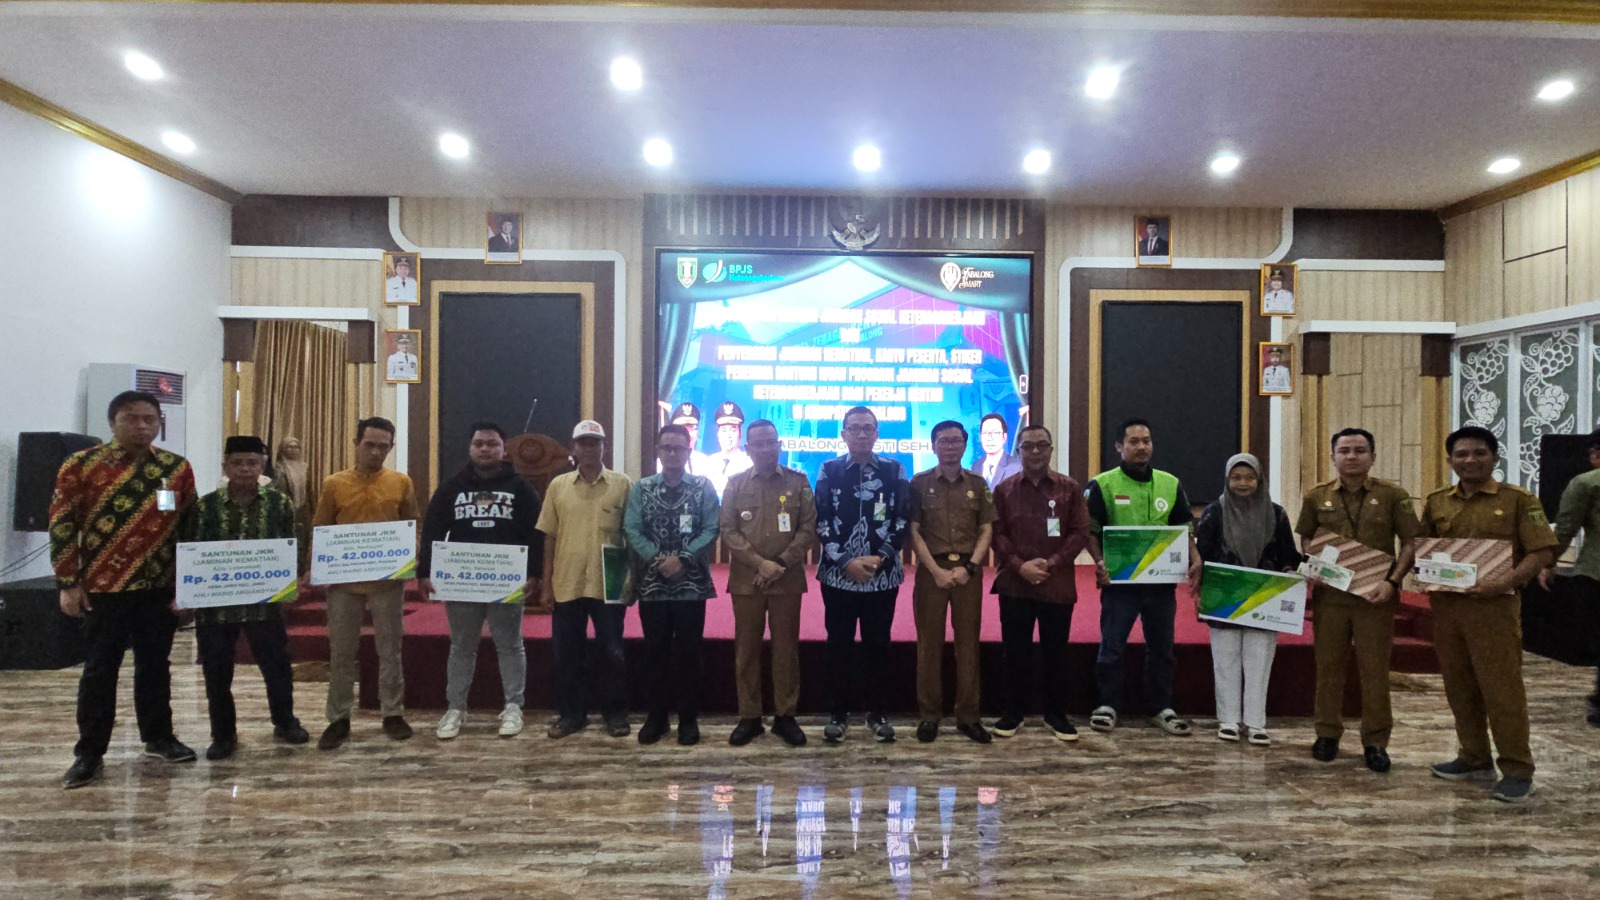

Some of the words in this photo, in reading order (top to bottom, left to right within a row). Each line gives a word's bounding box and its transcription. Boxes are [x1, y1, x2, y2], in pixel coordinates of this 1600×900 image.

[729, 265, 753, 274] BPJS
[962, 267, 994, 280] TABALONG
[454, 504, 514, 520] BREAK
[333, 531, 377, 539] SANTUNAN
[325, 539, 360, 547] (JAMINAN
[201, 549, 252, 558] SANTUNAN
[317, 554, 338, 564] Rp.
[341, 548, 410, 560] 42.000.000
[450, 551, 491, 559] SANTUNAN
[183, 575, 207, 585] Rp.
[211, 569, 291, 582] 42.000.000
[435, 571, 454, 580] Rp.
[457, 571, 521, 582] 42.000.000
